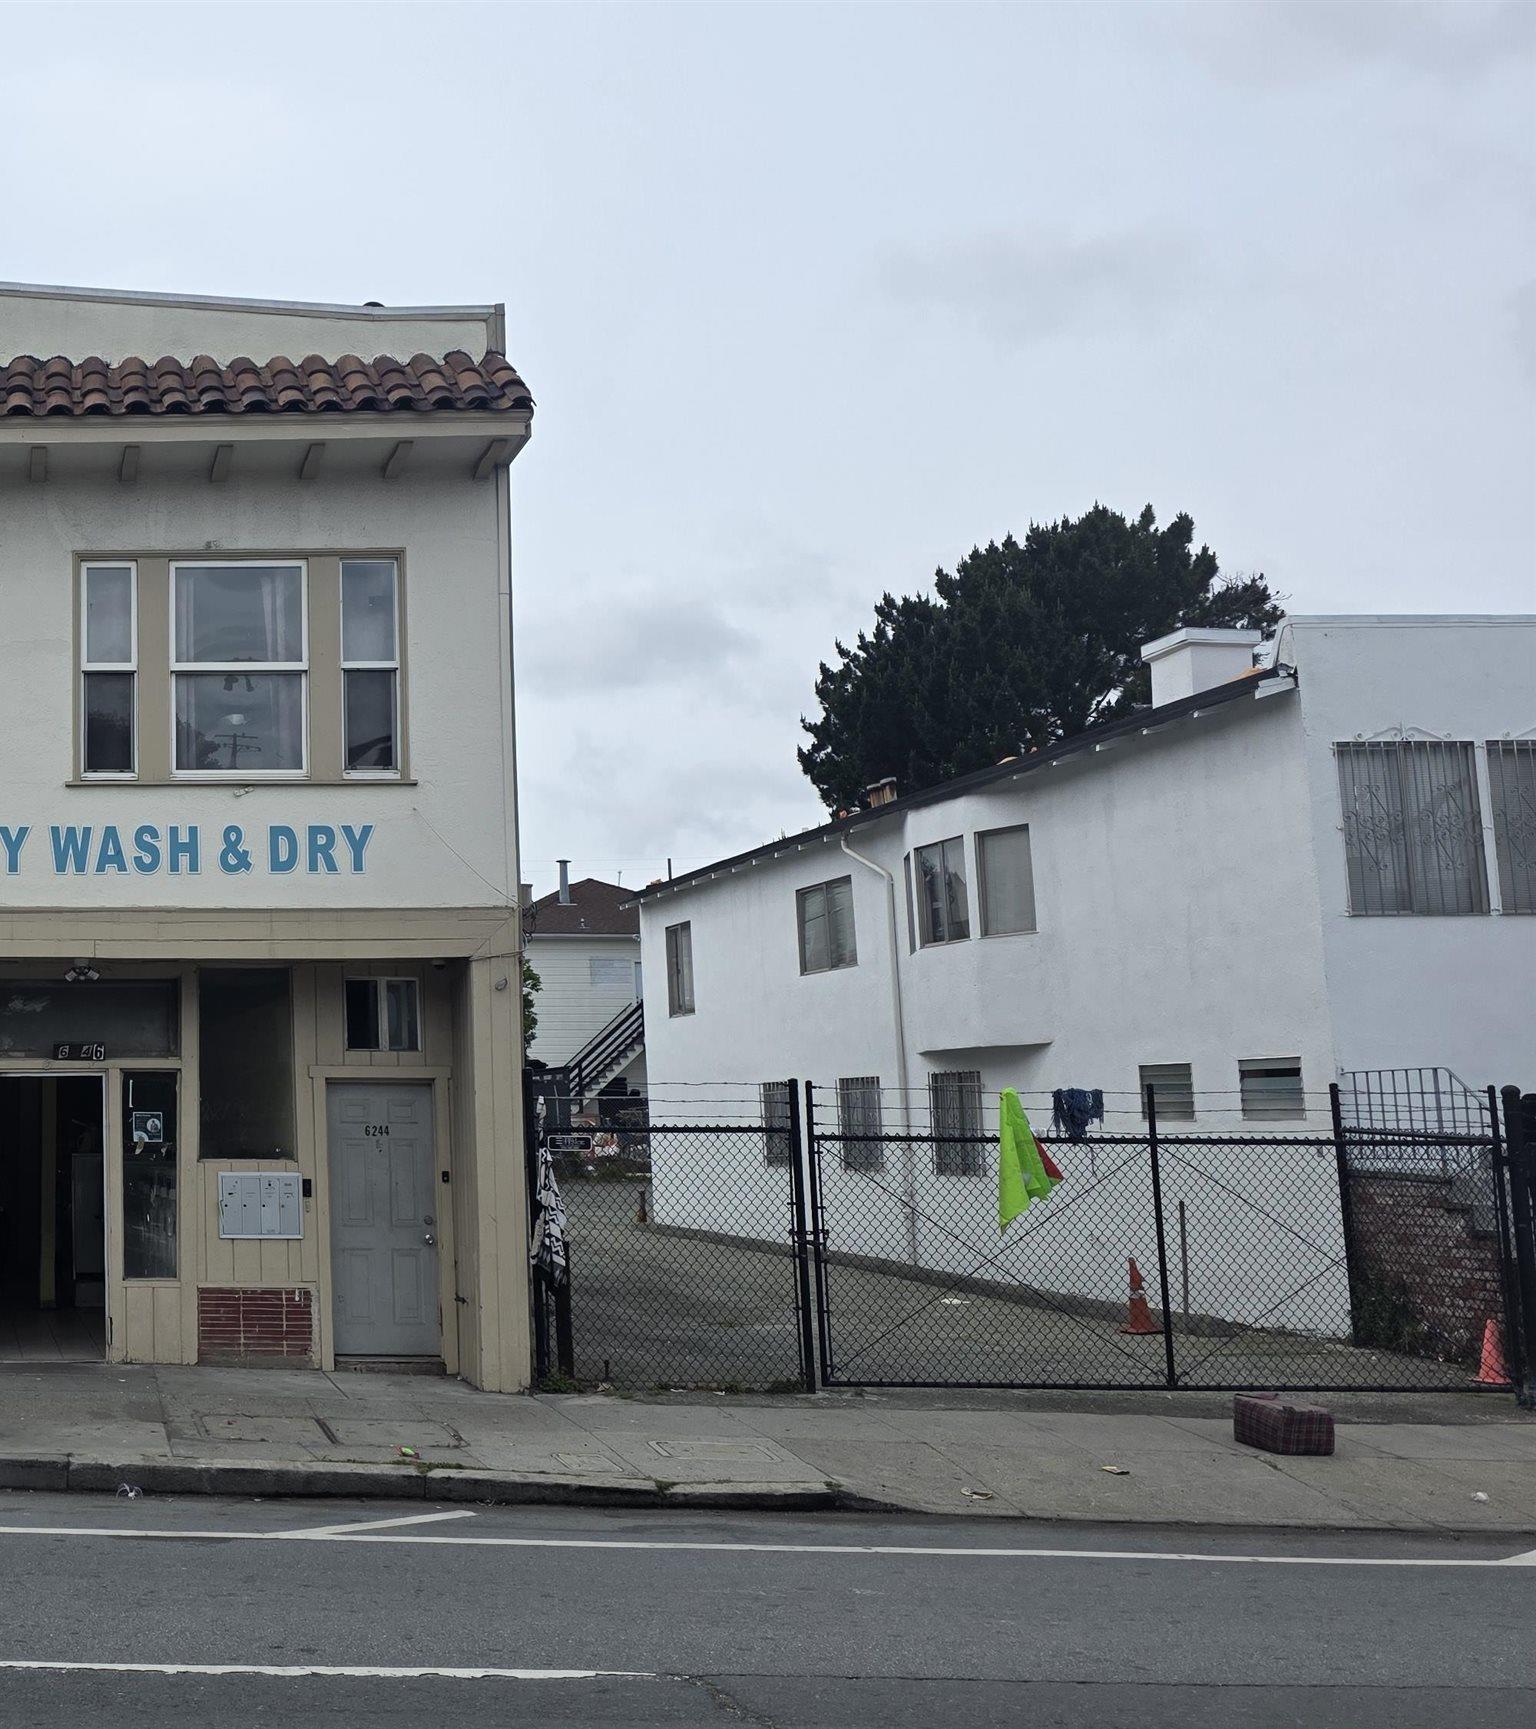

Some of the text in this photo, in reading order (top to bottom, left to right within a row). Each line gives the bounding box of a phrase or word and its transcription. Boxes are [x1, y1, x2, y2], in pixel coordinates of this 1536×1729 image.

[50, 824, 200, 874] WASH
[218, 824, 253, 874] &
[269, 824, 375, 873] DRY
[364, 1125, 390, 1137] 6244
